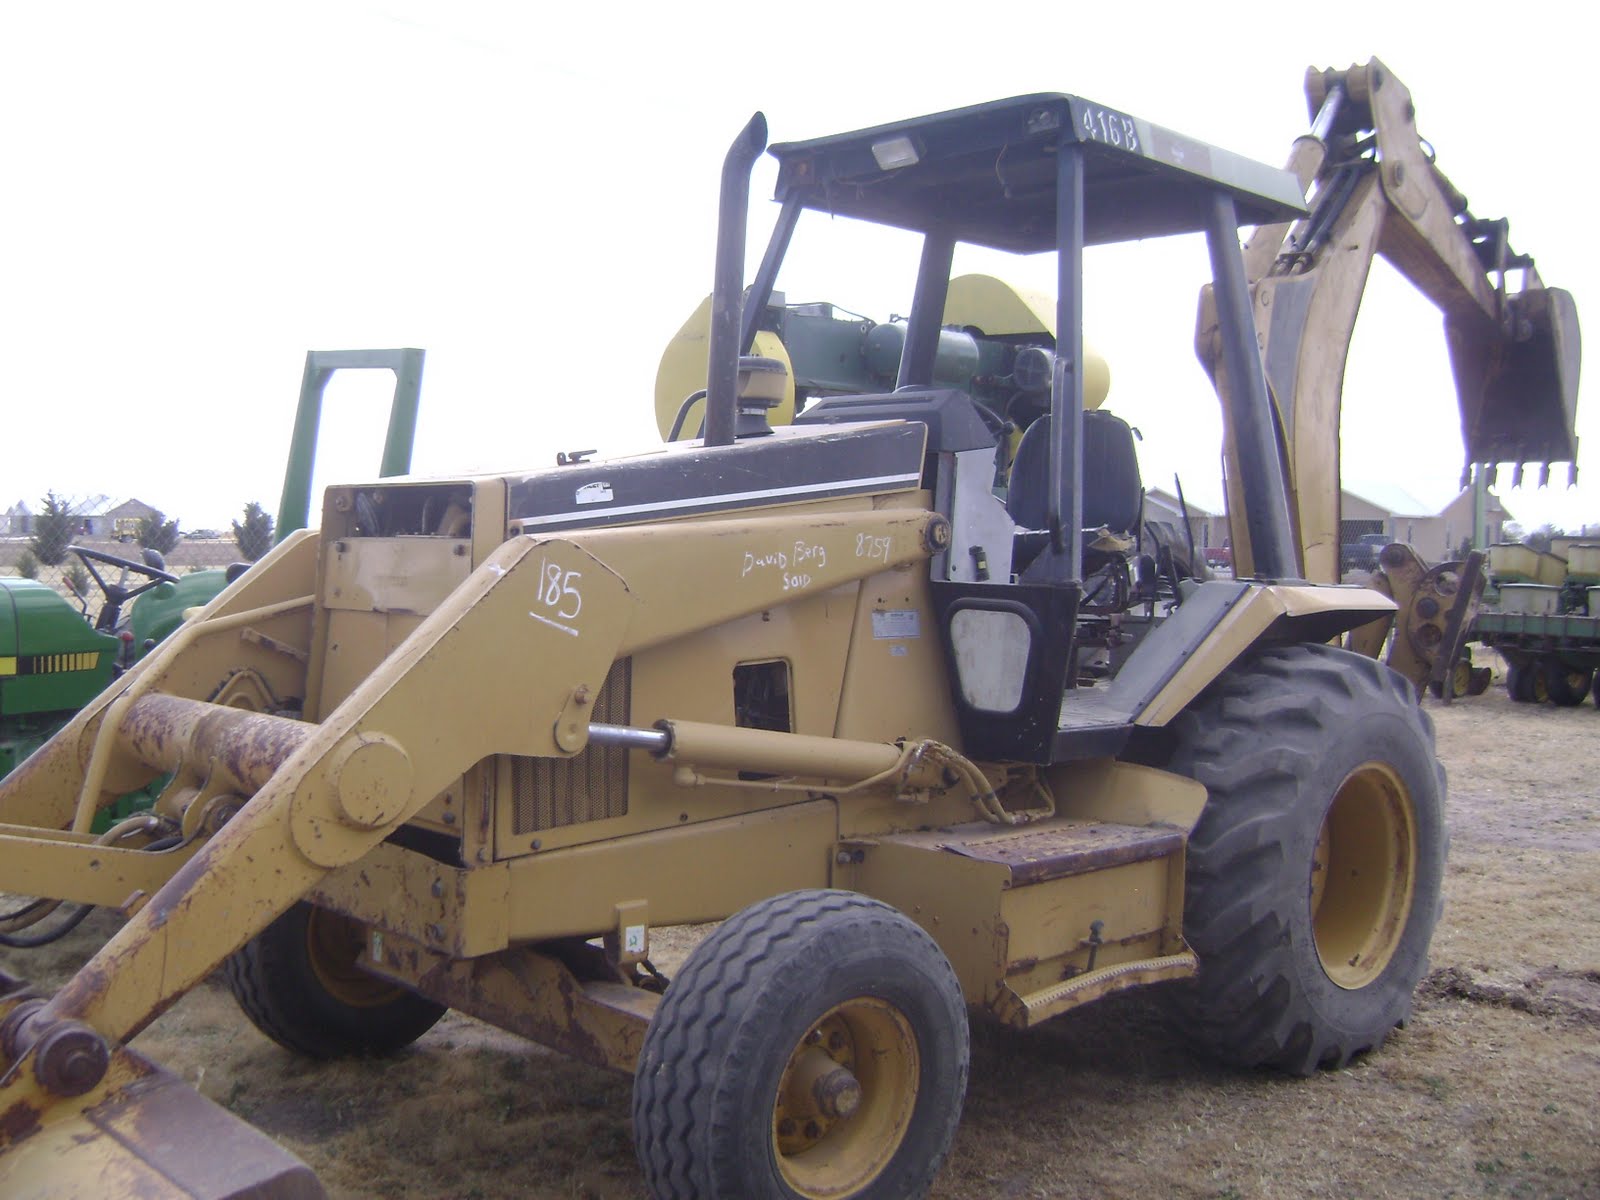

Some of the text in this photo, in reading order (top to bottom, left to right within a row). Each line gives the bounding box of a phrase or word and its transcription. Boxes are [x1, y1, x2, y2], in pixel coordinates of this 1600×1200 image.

[1083, 108, 1137, 151] 416B
[855, 532, 891, 564] 8759
[537, 556, 582, 619] 185
